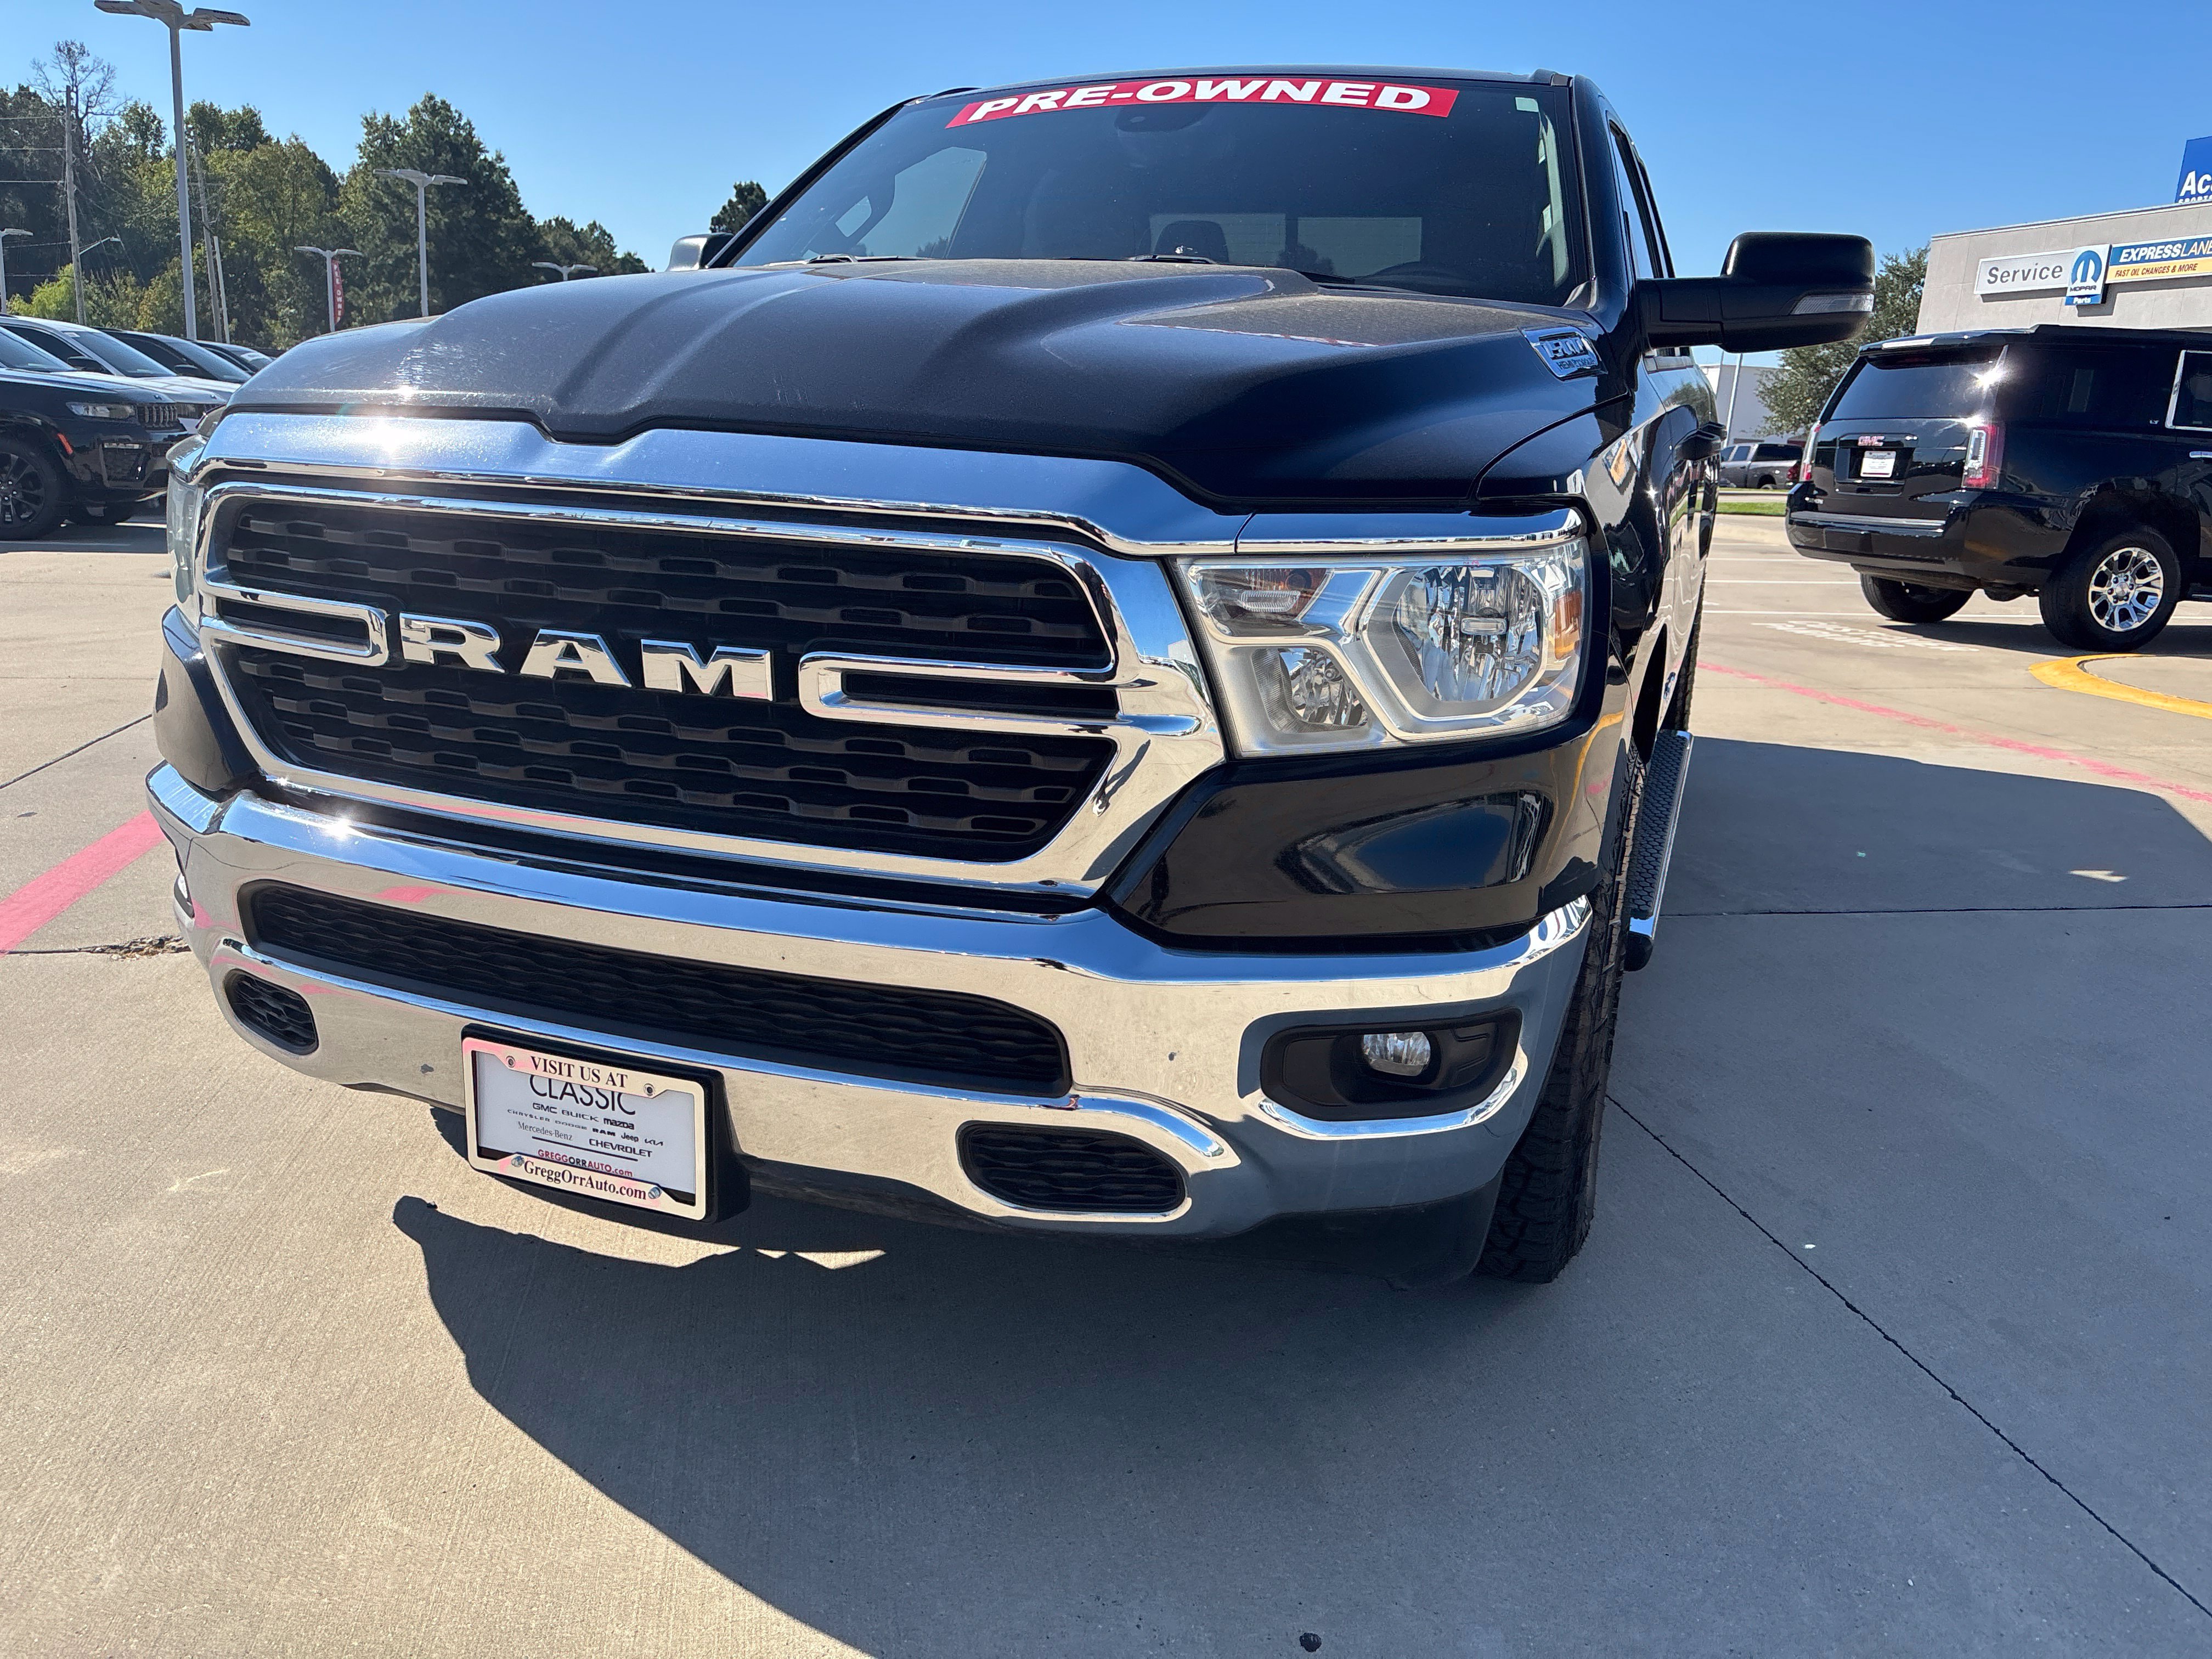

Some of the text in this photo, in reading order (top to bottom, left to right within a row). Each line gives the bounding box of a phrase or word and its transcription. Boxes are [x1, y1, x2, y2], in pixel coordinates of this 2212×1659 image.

[968, 79, 1431, 122] PRE-OWNED
[2180, 170, 2212, 197] Ac
[2119, 240, 2212, 263] EXPRESSLANE
[1987, 263, 2063, 284] Service
[2114, 269, 2130, 278] FAST
[2141, 265, 2171, 275] CHANGES
[2171, 265, 2177, 273] &
[2177, 263, 2198, 272] MORE
[1858, 436, 1885, 447] GMC
[399, 612, 774, 702] RAM
[531, 1056, 628, 1088] VISIT US AT
[529, 1074, 636, 1115] CLASSIC
[507, 1109, 550, 1122] CHRYSLER
[555, 1120, 588, 1130] DODGE
[592, 1127, 616, 1137] RAM
[620, 1132, 639, 1143] Jeep
[532, 1102, 635, 1130] GMC BUICK mazda
[518, 1121, 653, 1158] Mercedes-Benz CHEVROLET
[538, 1149, 633, 1177] GREGGORRAUTO.com
[524, 1160, 647, 1200] GreggOrrAuto.com
